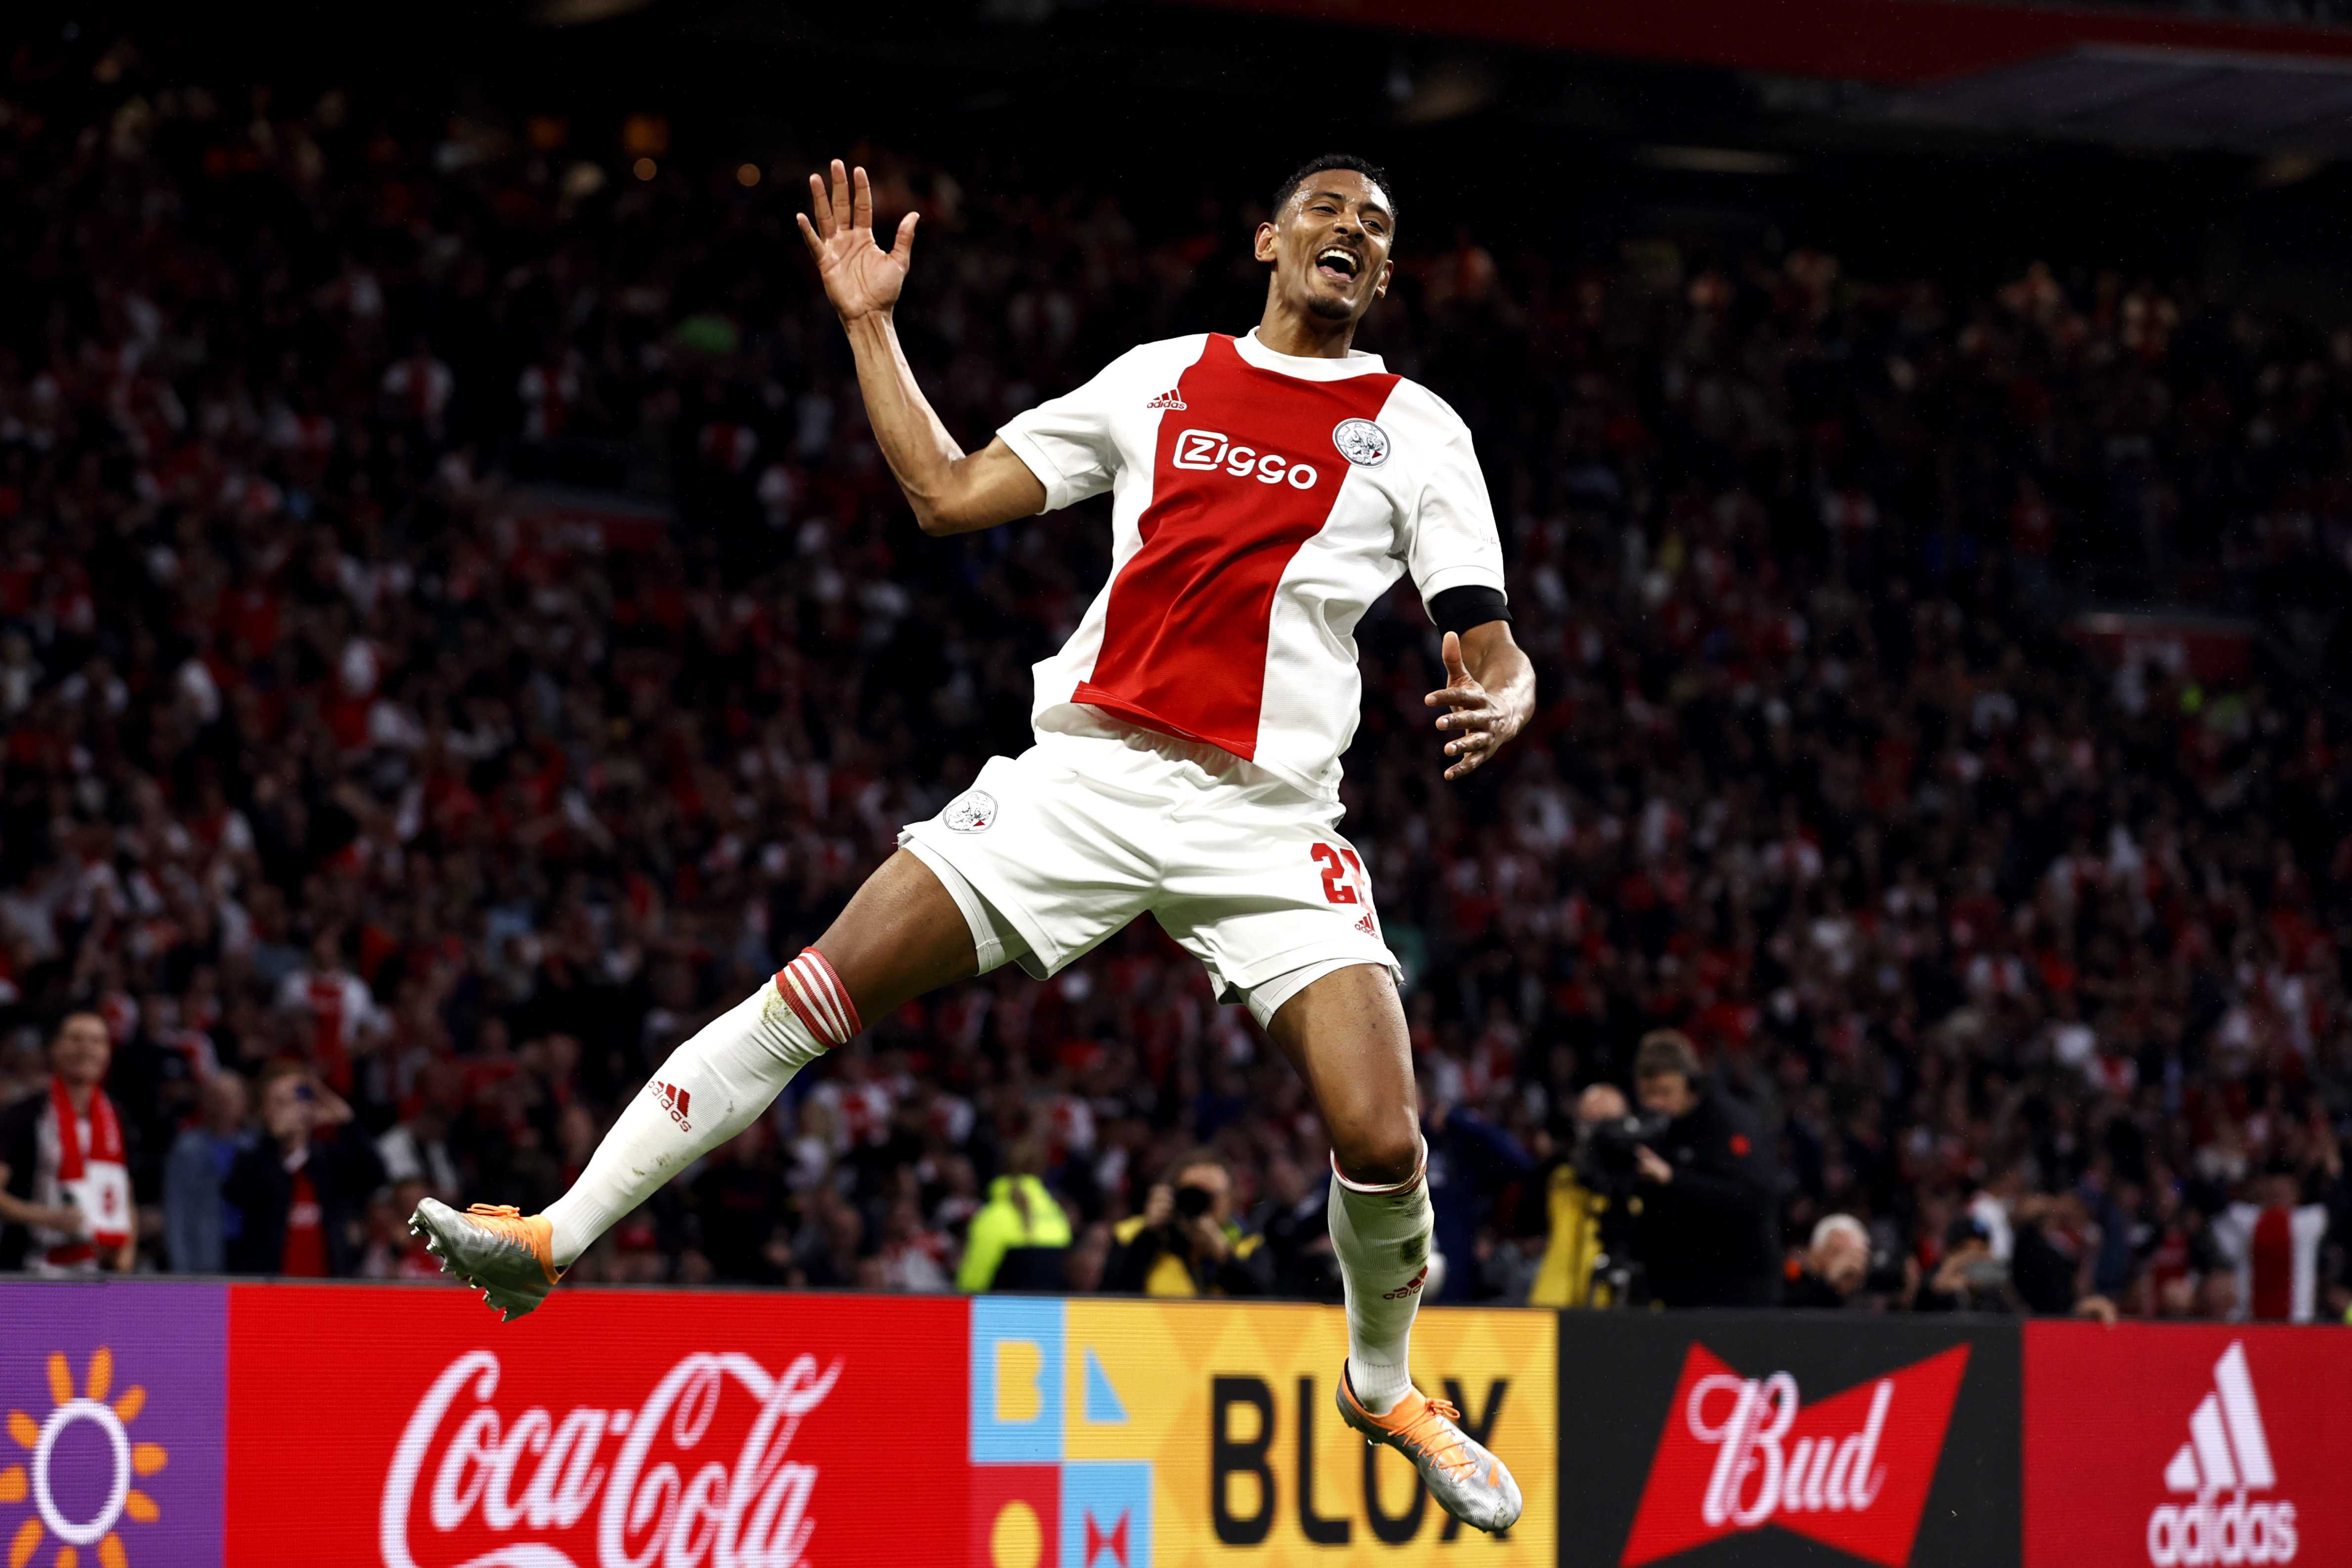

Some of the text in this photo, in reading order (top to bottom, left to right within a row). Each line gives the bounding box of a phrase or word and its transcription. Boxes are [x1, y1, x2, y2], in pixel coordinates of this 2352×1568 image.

[1146, 399, 1186, 409] adidas
[1181, 435, 1317, 489] Ziggo
[648, 1081, 692, 1132] adidas
[1686, 1372, 1894, 1526] Bud
[2147, 1485, 2299, 1568] adidas
